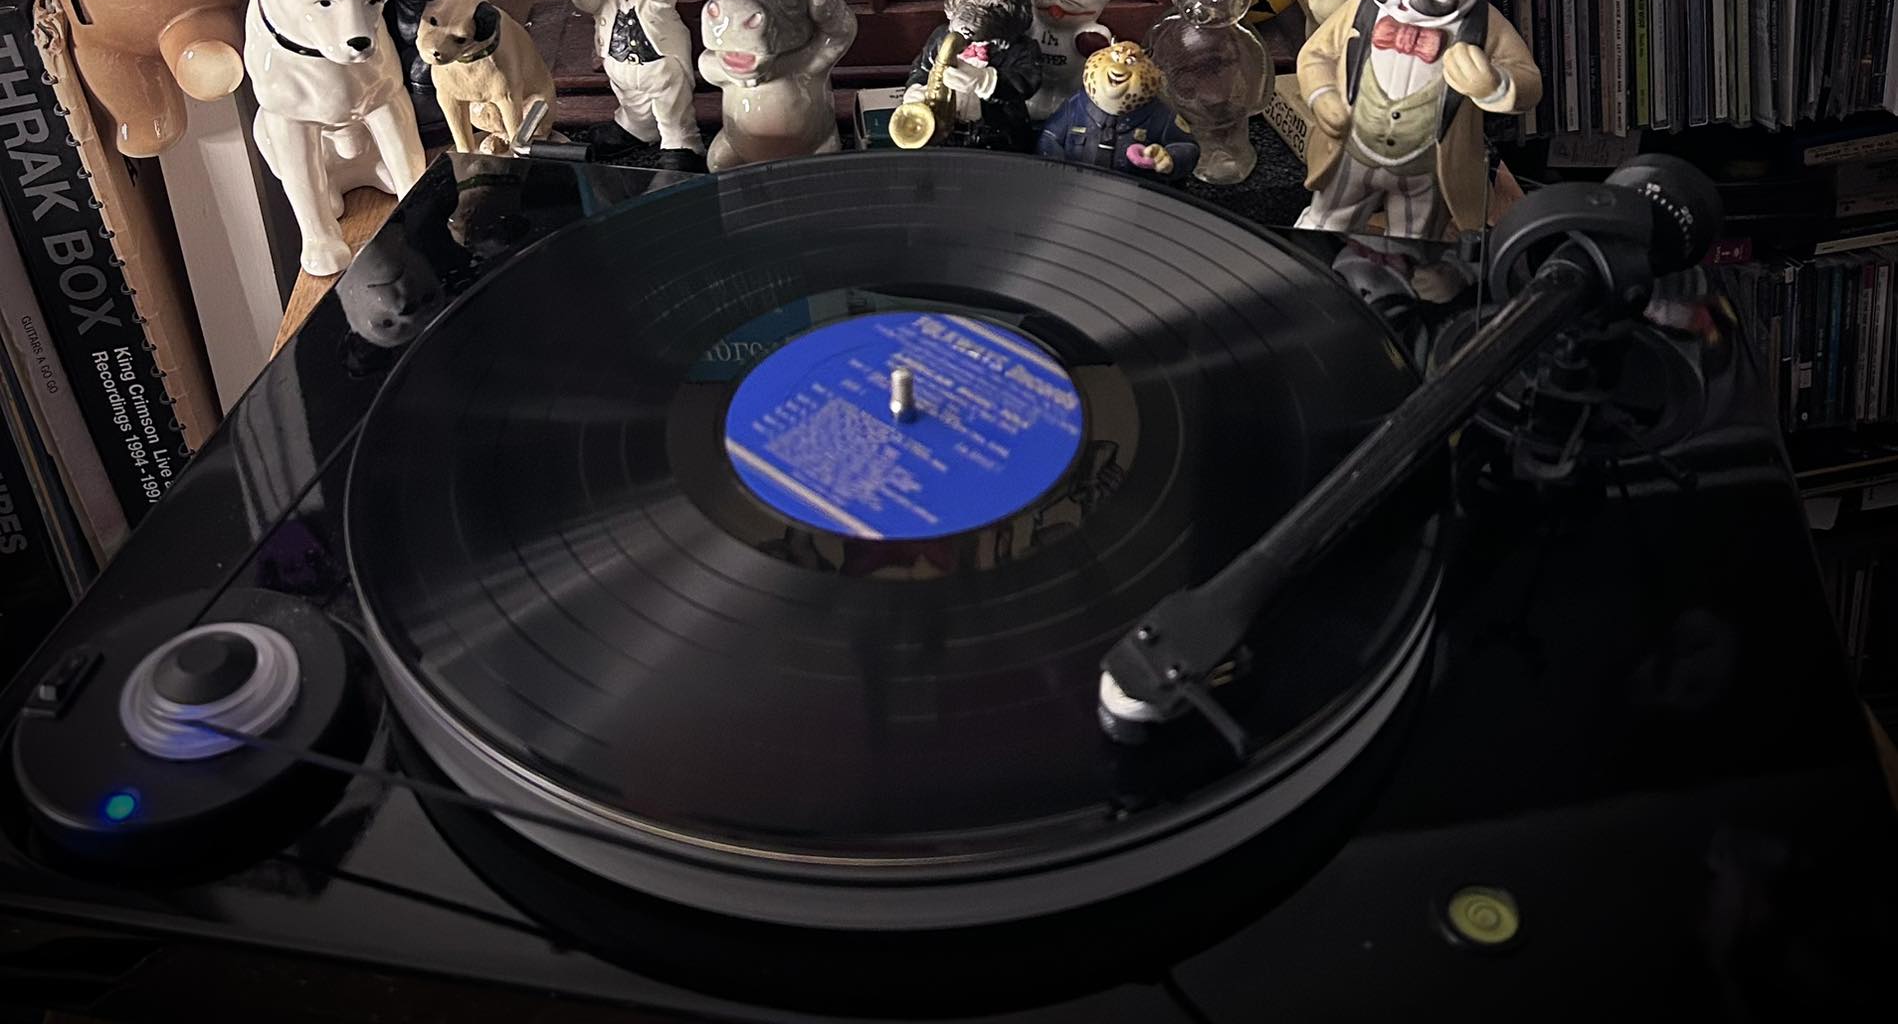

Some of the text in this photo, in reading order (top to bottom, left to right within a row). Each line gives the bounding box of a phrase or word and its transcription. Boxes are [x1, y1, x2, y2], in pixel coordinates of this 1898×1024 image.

[0, 34, 122, 336] THRAK BOX
[22, 315, 58, 394] GUITARS A GO GO
[92, 351, 132, 431] Recordings
[114, 347, 172, 478] King Crimson Live
